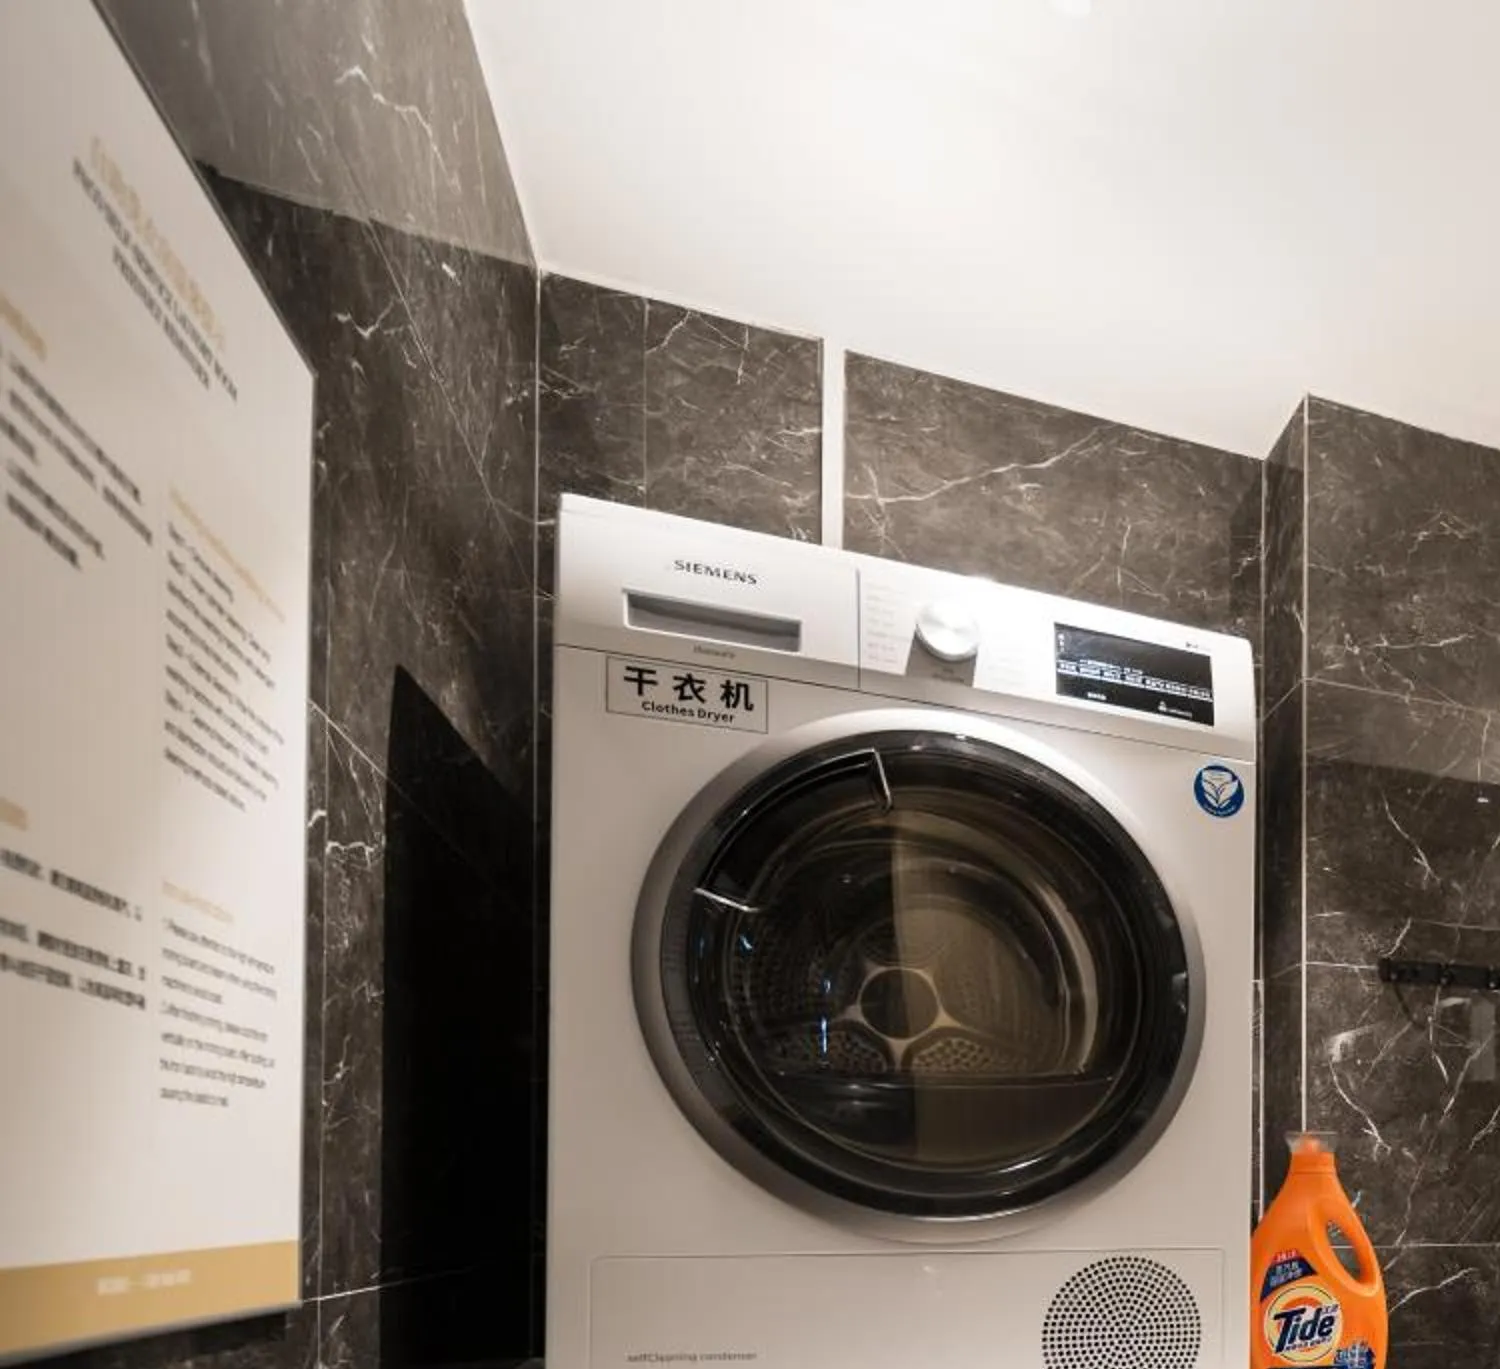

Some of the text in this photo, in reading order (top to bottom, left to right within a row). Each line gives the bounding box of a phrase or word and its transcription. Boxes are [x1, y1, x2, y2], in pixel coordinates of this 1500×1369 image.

[674, 559, 758, 585] SIEMENS
[623, 665, 755, 711] 干衣机
[641, 700, 735, 724] Clothes Dryer
[1273, 1306, 1335, 1354] Tide
